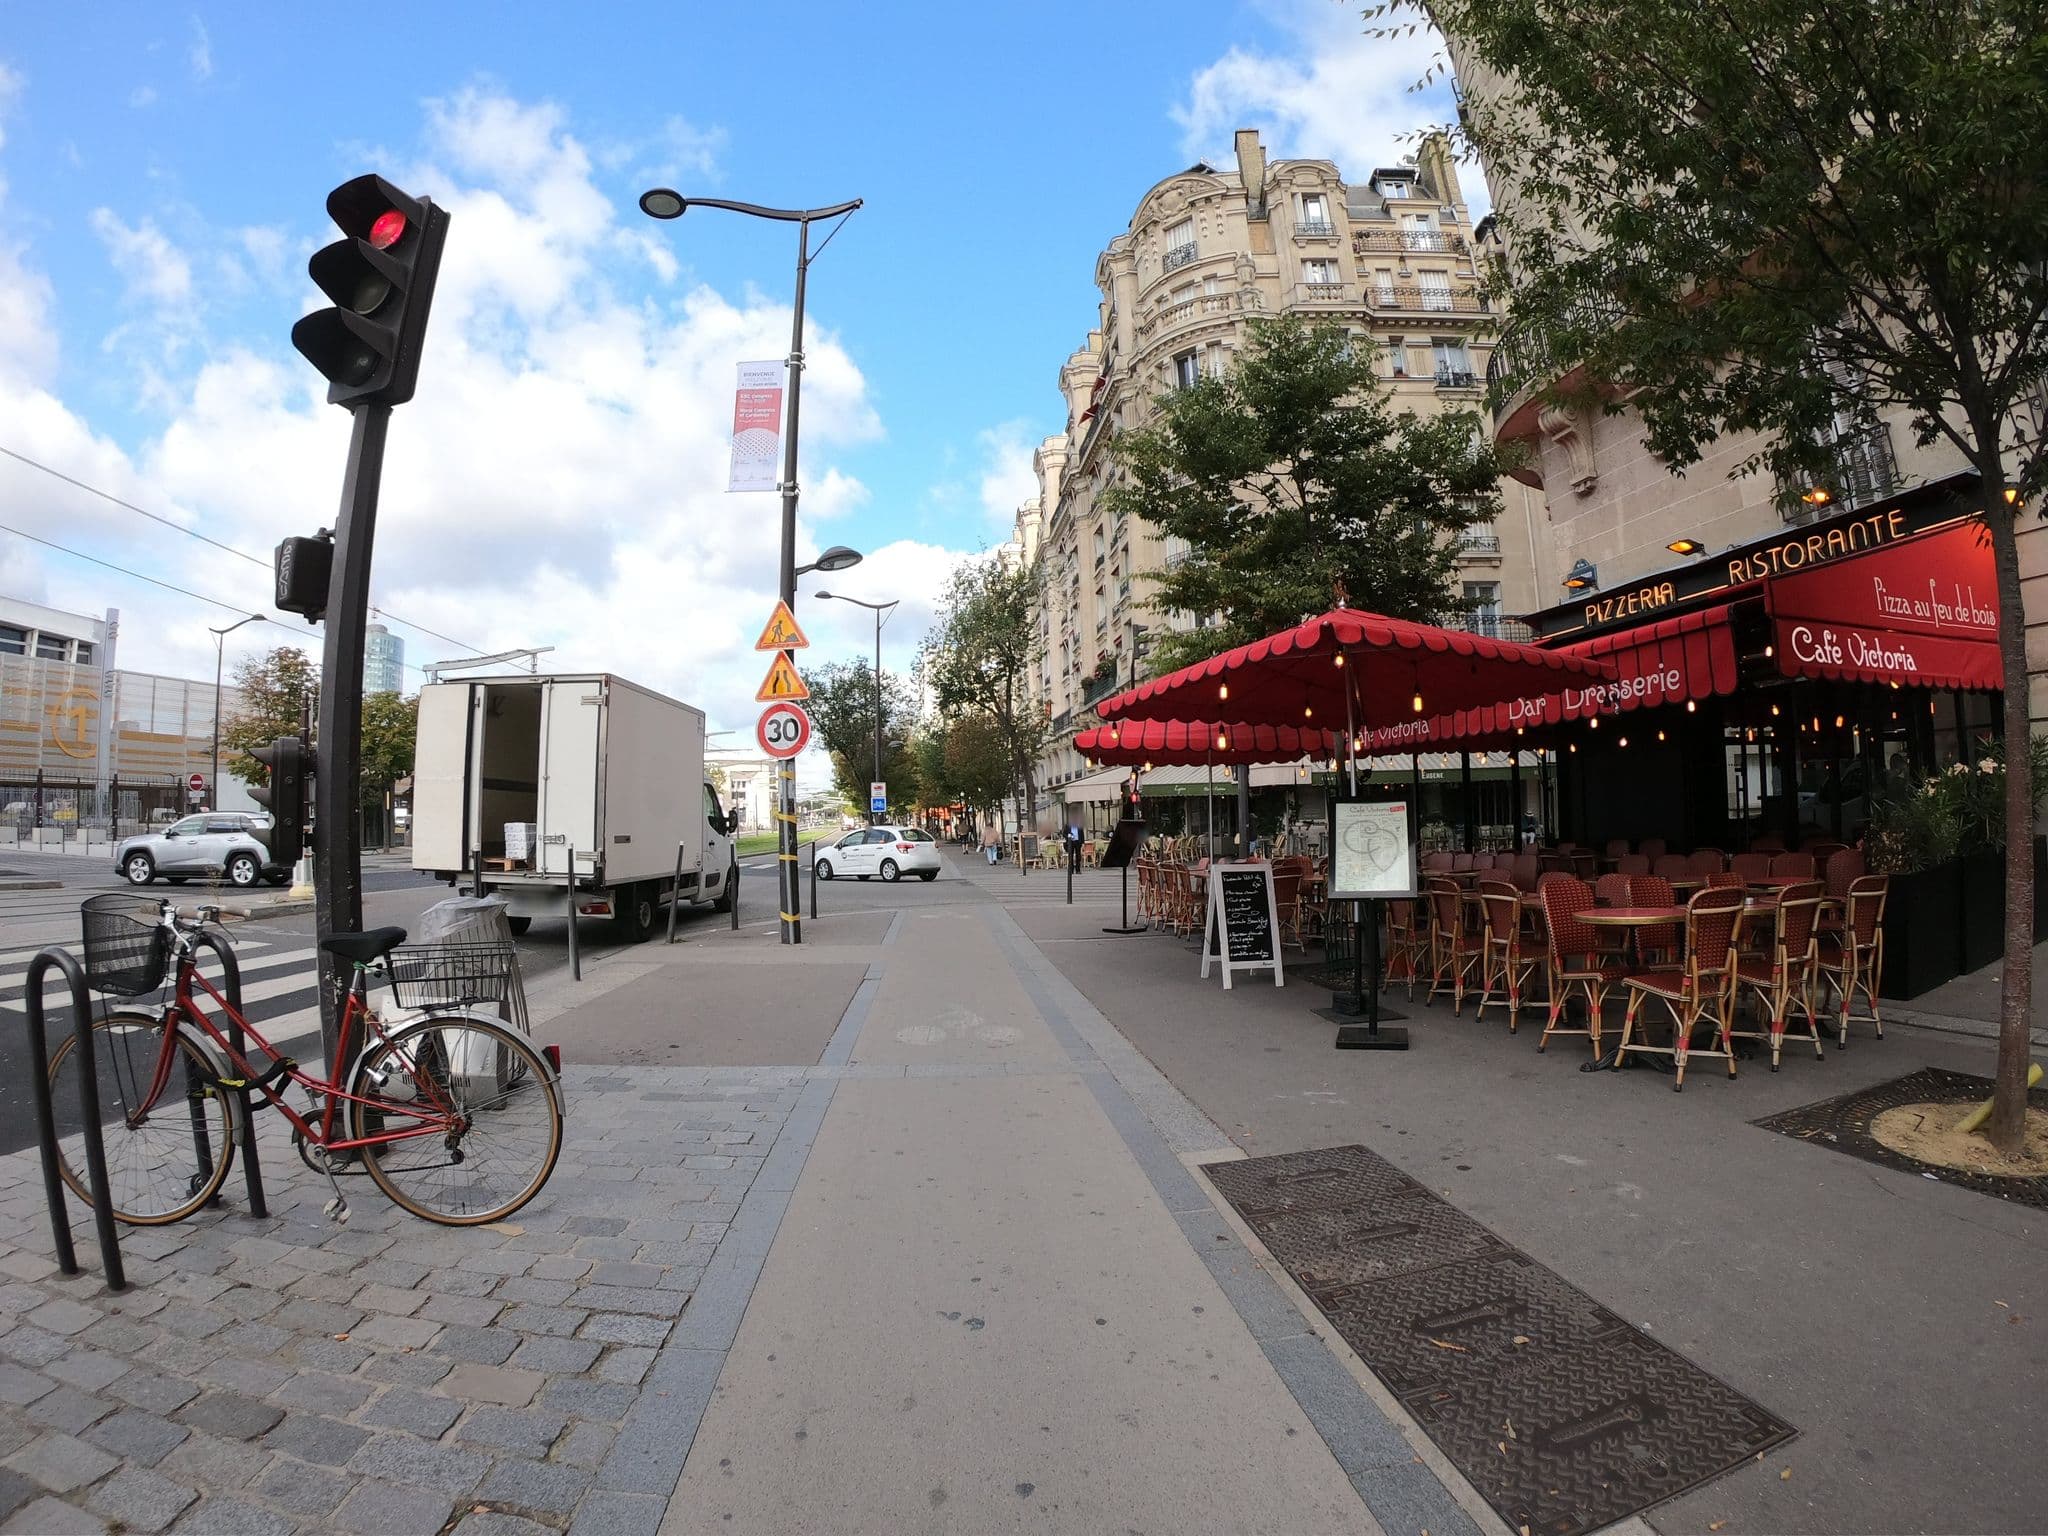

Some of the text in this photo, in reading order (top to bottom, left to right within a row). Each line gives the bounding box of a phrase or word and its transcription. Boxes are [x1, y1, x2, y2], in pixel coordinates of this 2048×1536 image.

[1585, 509, 1907, 625] PIZZERIA RISTORANTE
[1874, 576, 1997, 628] Pizza au feu de bois
[1791, 626, 1917, 671] Café Victoria
[768, 718, 799, 742] 30
